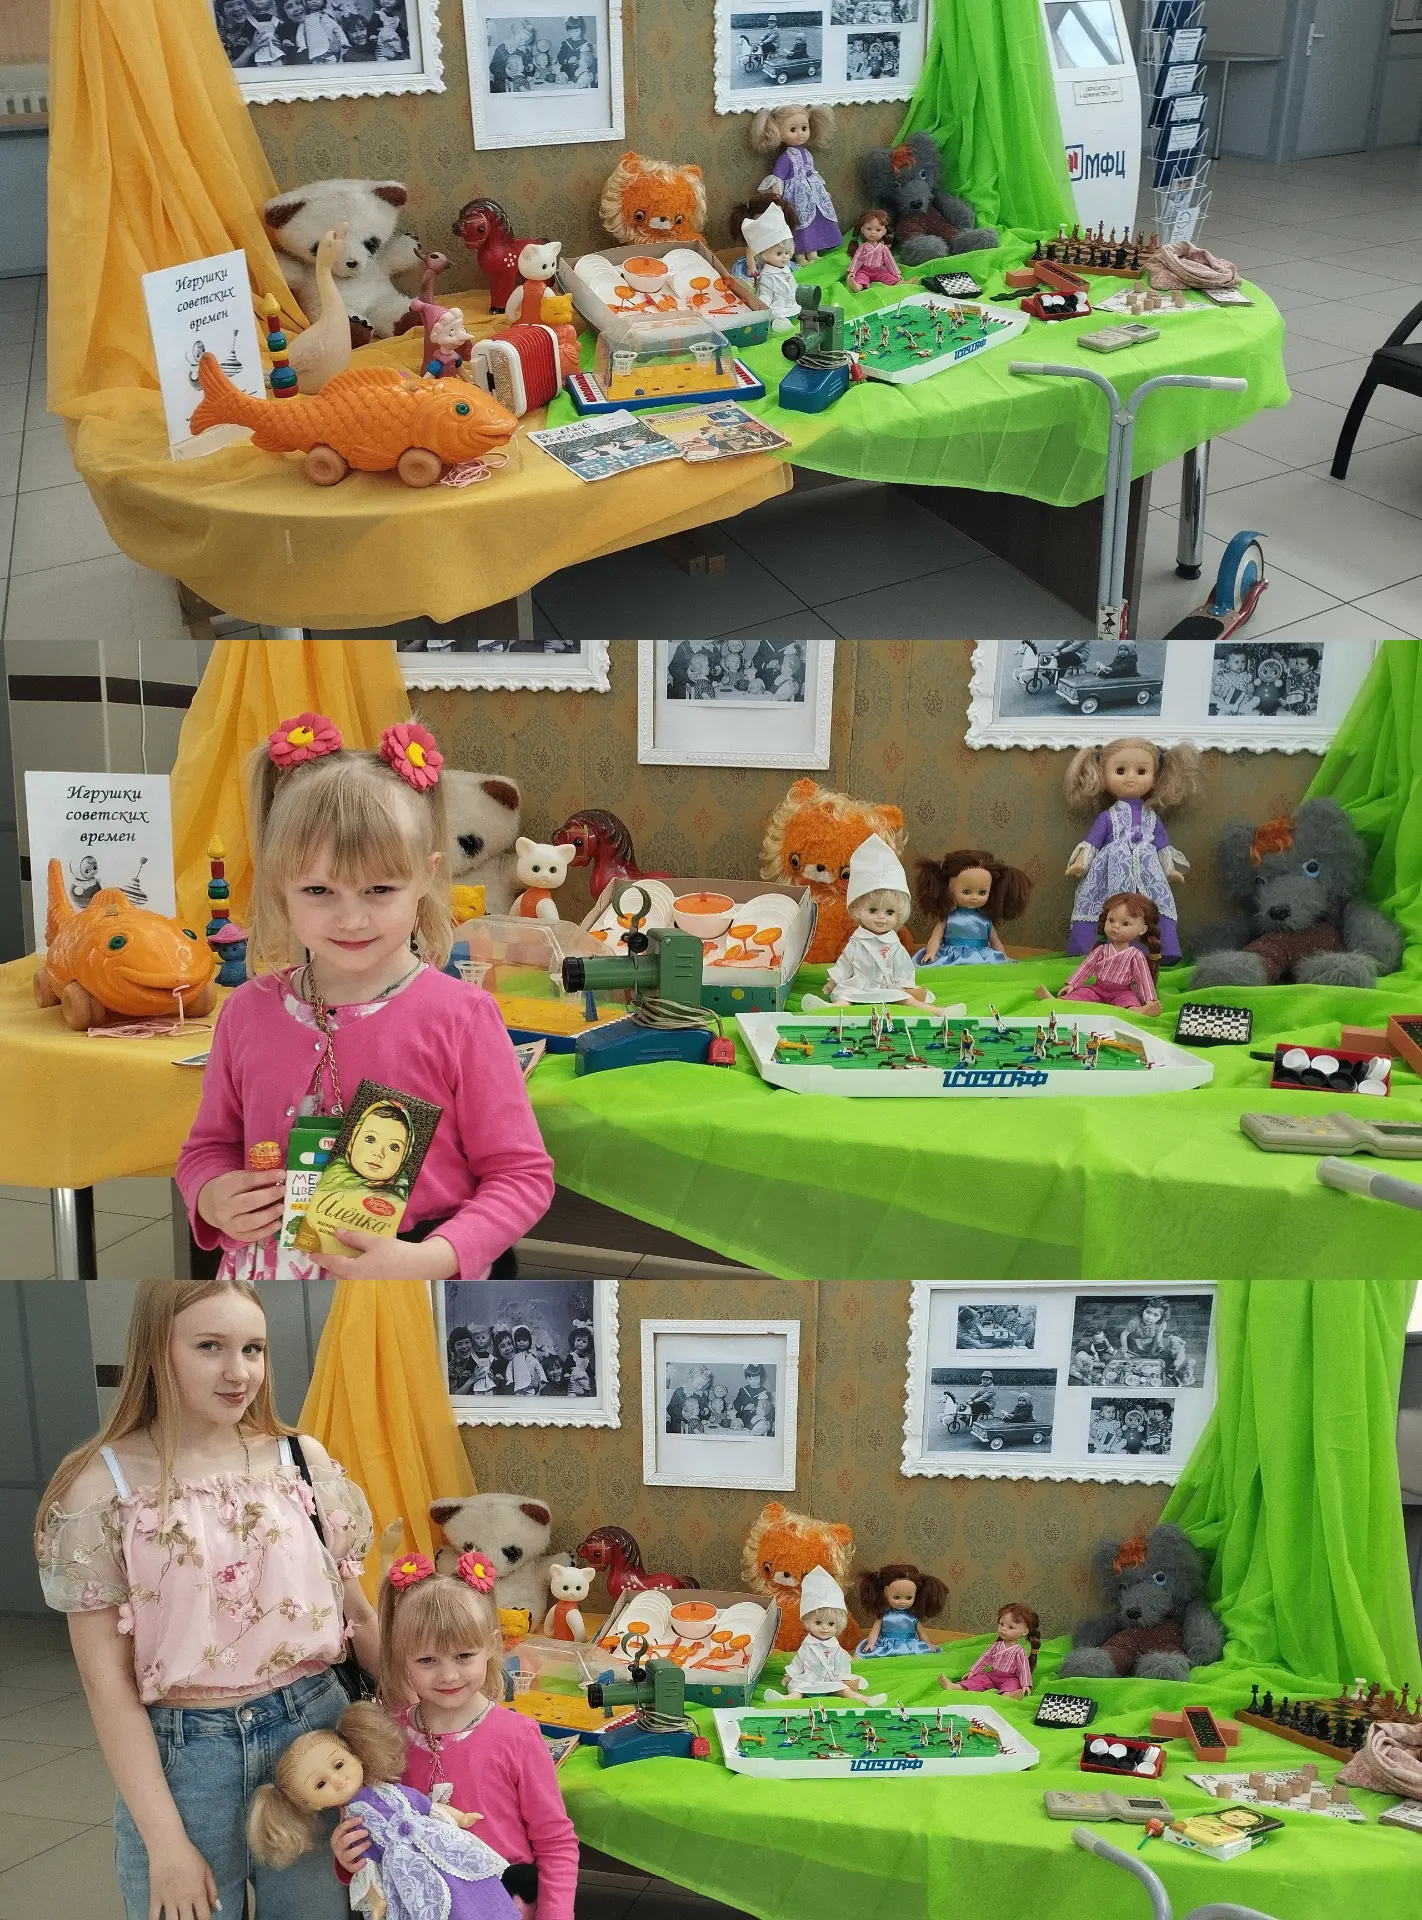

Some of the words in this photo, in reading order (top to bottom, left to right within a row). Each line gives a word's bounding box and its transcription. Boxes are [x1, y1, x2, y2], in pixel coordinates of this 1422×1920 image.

[1085, 150, 1126, 180] МФЦ
[175, 268, 229, 292] Игрушки
[177, 286, 236, 313] советских
[189, 309, 229, 332] времен
[67, 785, 142, 803] Игрушки
[66, 811, 150, 824] советских
[80, 832, 136, 846] времен
[315, 1190, 385, 1234] Алёнка
